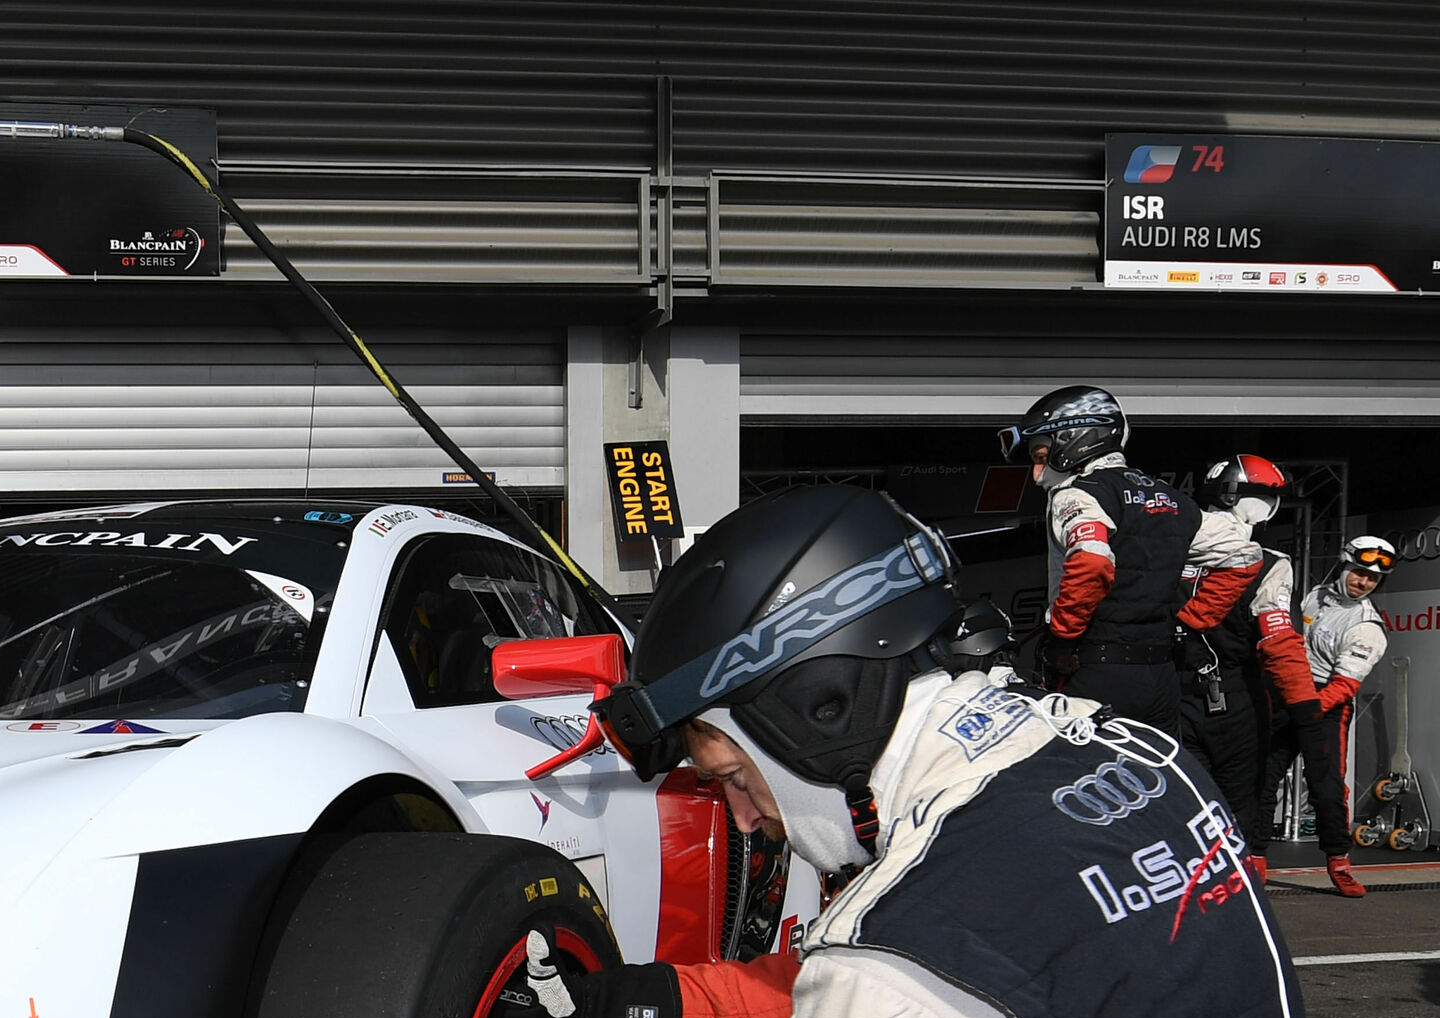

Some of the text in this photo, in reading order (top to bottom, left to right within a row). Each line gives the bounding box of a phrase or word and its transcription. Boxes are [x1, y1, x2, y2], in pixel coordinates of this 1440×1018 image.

[1191, 145, 1225, 173] 74
[1122, 195, 1165, 220] ISR
[109, 239, 187, 251] BLANCPAIN
[1121, 225, 1262, 250] AUDI R8 LMS
[121, 257, 176, 267] GT SERIES
[612, 447, 648, 535] ENGINE
[641, 452, 674, 526] START
